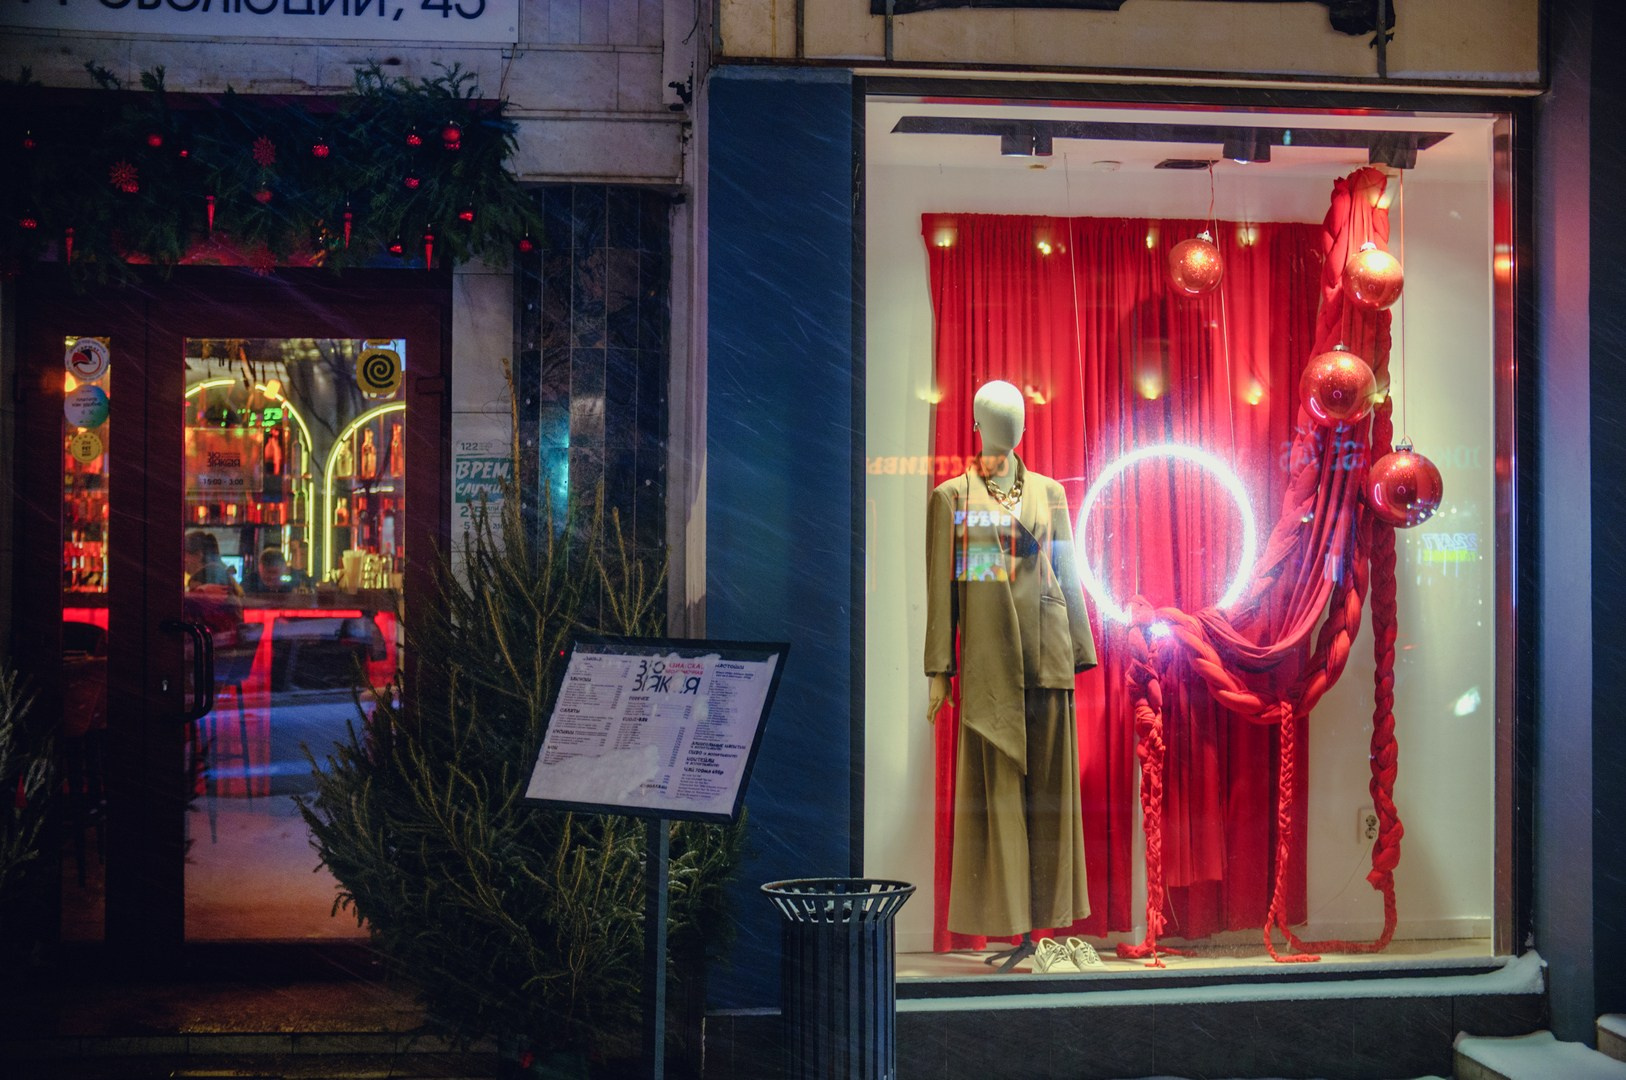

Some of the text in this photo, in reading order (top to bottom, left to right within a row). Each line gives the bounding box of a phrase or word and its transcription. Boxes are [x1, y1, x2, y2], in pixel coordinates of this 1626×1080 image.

[461, 442, 478, 451] 122
[456, 461, 511, 480] ВРЕМ
[456, 483, 507, 498] СЛУЖИ
